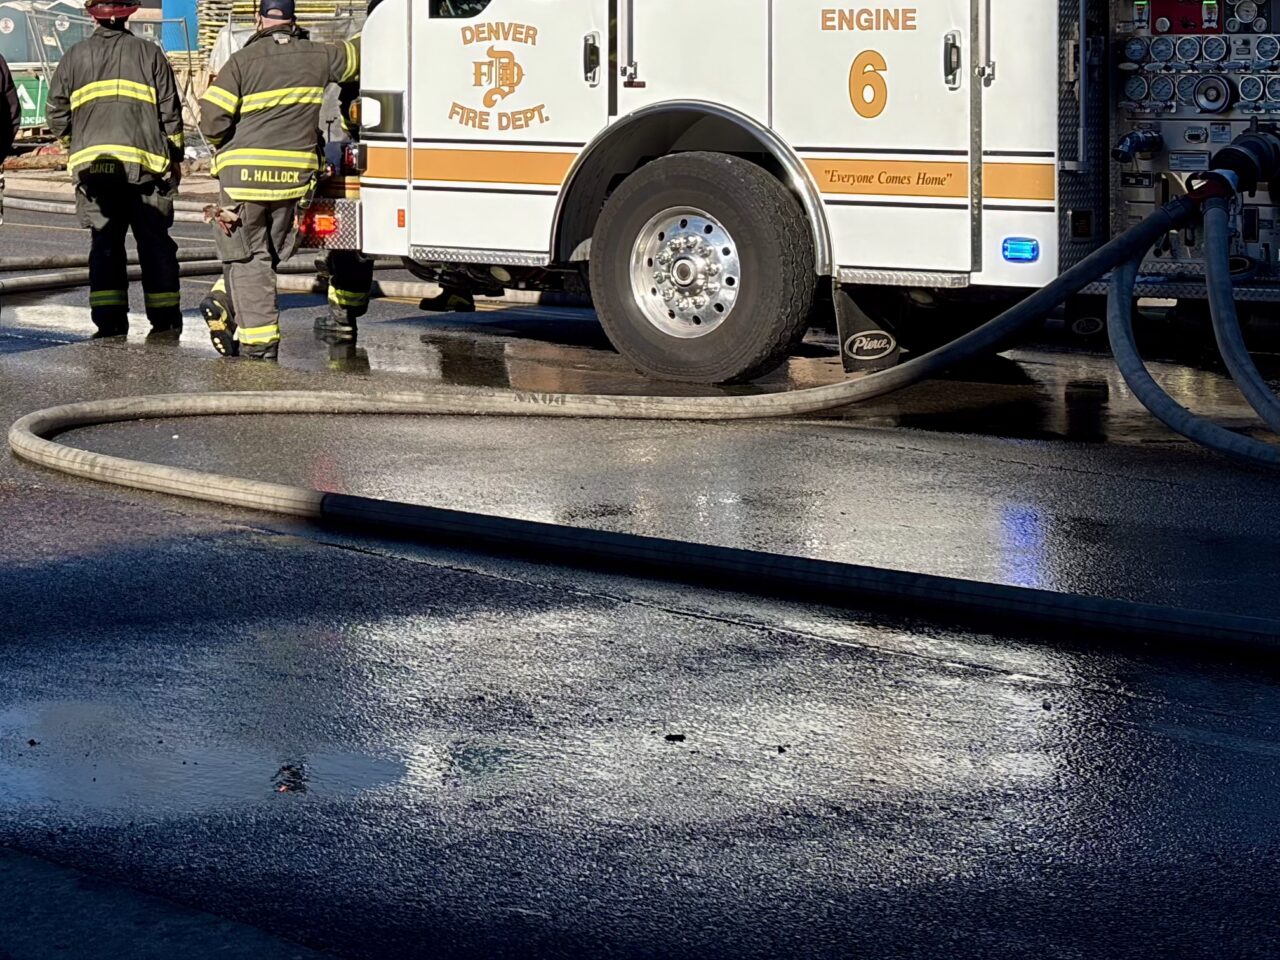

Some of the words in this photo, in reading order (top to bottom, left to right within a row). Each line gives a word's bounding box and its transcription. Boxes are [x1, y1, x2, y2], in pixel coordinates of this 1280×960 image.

[821, 8, 917, 31] ENGINE
[461, 21, 538, 46] DENVER
[848, 49, 888, 119] 6
[448, 101, 490, 130] FIRE
[498, 104, 550, 131] DEPT.
[241, 168, 252, 181] D.
[254, 170, 300, 183] HALLOCK
[824, 169, 875, 186] "Everyone
[877, 171, 911, 185] Comes
[916, 172, 953, 186] Home"
[852, 336, 890, 353] Pierce
